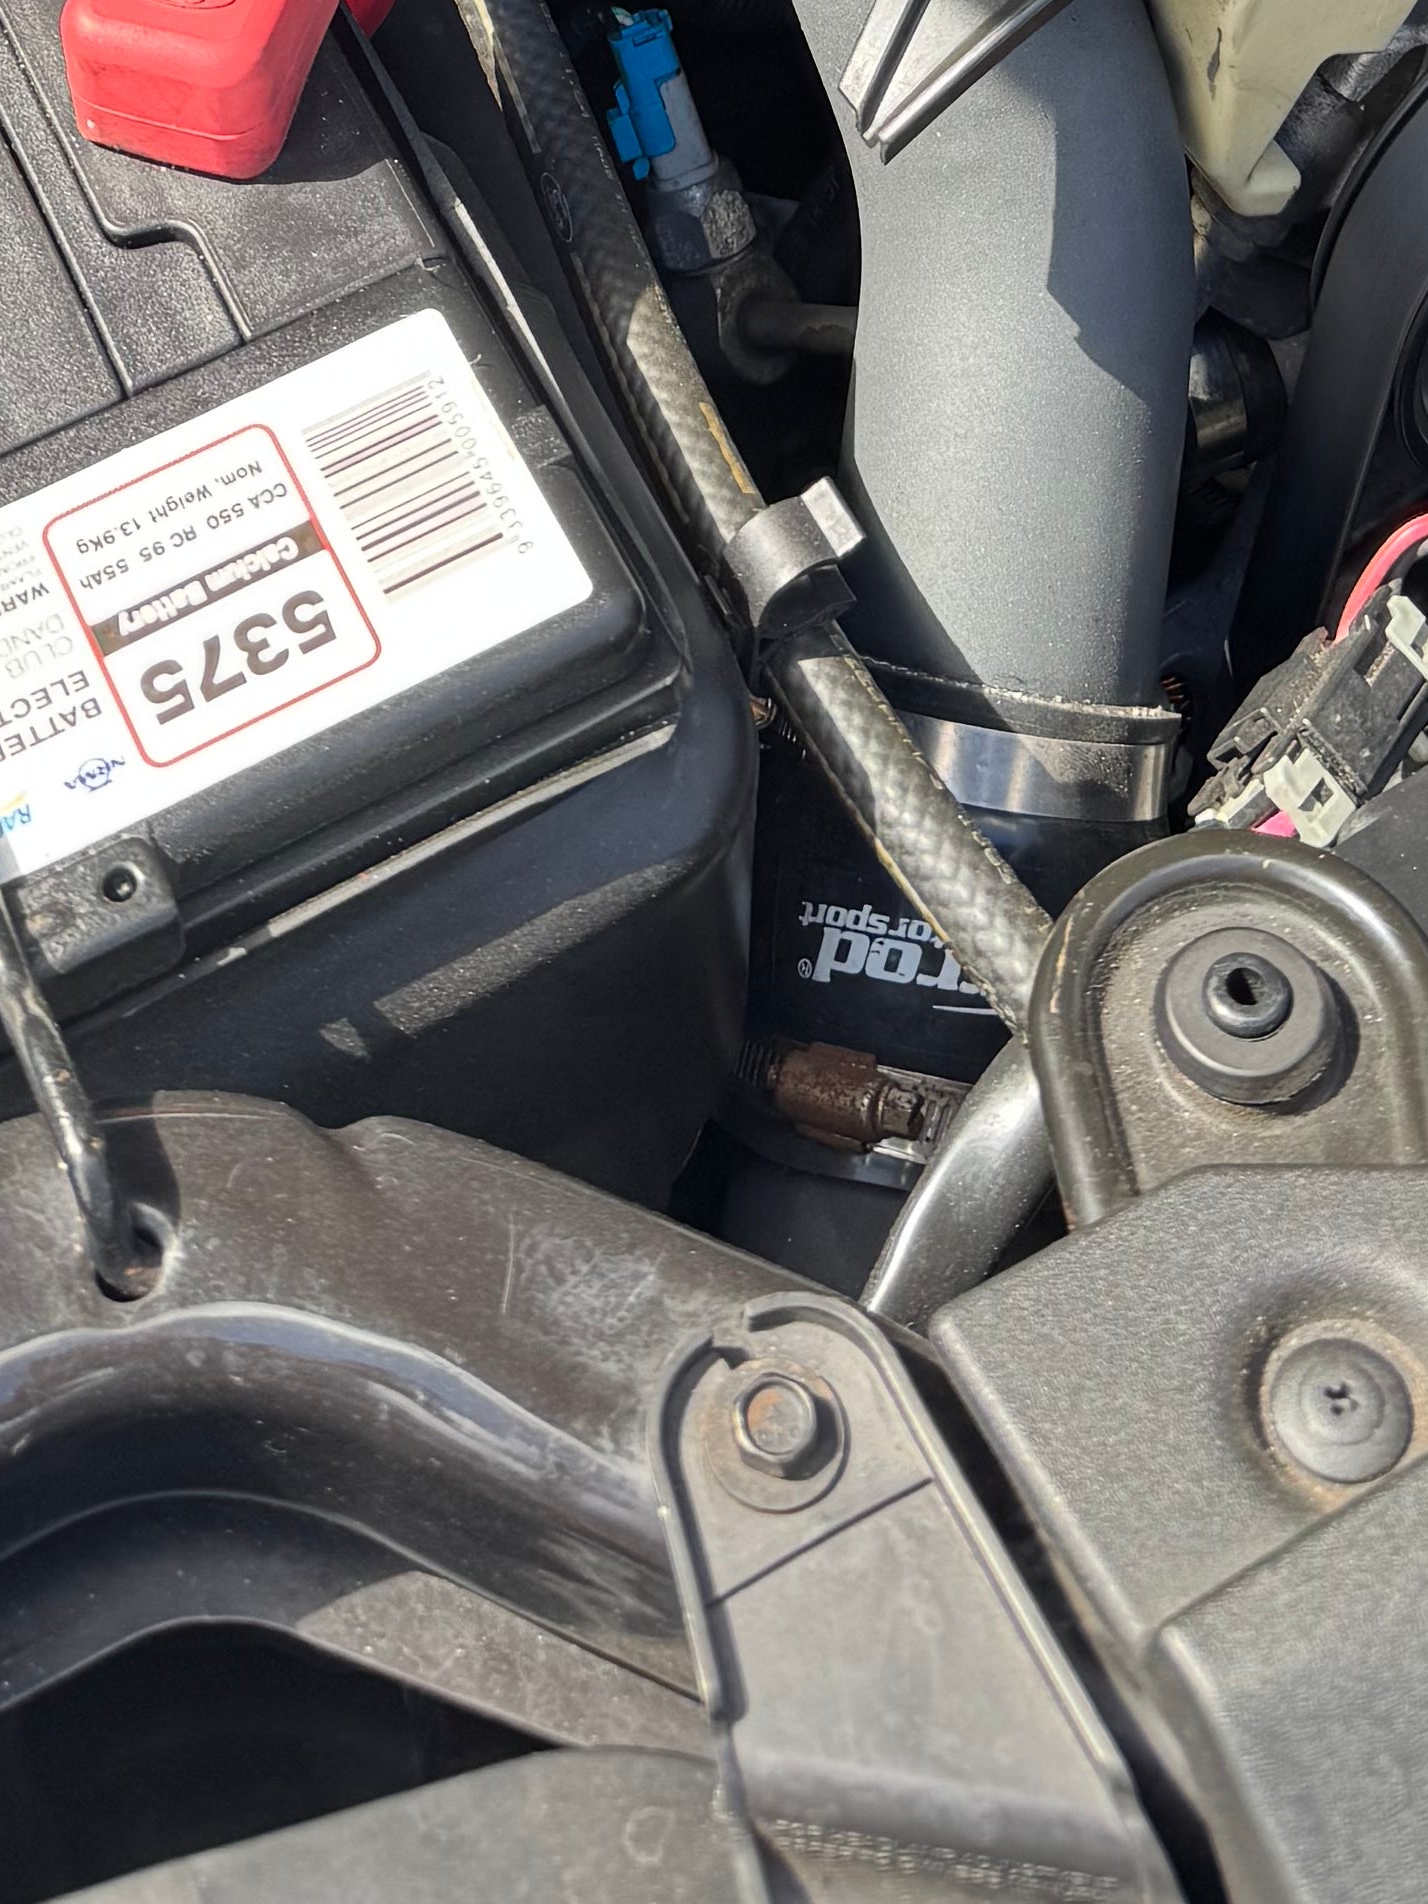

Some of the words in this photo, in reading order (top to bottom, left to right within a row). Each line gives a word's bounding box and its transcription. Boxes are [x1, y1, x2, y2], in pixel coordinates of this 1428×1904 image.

[148, 485, 212, 522] Weight
[247, 483, 287, 508] CCA
[206, 502, 244, 529] 550
[76, 518, 140, 553] 13.9Kg
[139, 541, 165, 561] 95
[169, 525, 196, 547] RC
[80, 558, 128, 589] 55Ah
[201, 532, 301, 597] Calcium
[111, 575, 209, 641] Battery
[1, 630, 77, 682] CLUB
[140, 590, 336, 724] 5375
[798, 901, 945, 949] orsport
[812, 927, 981, 995] rod
